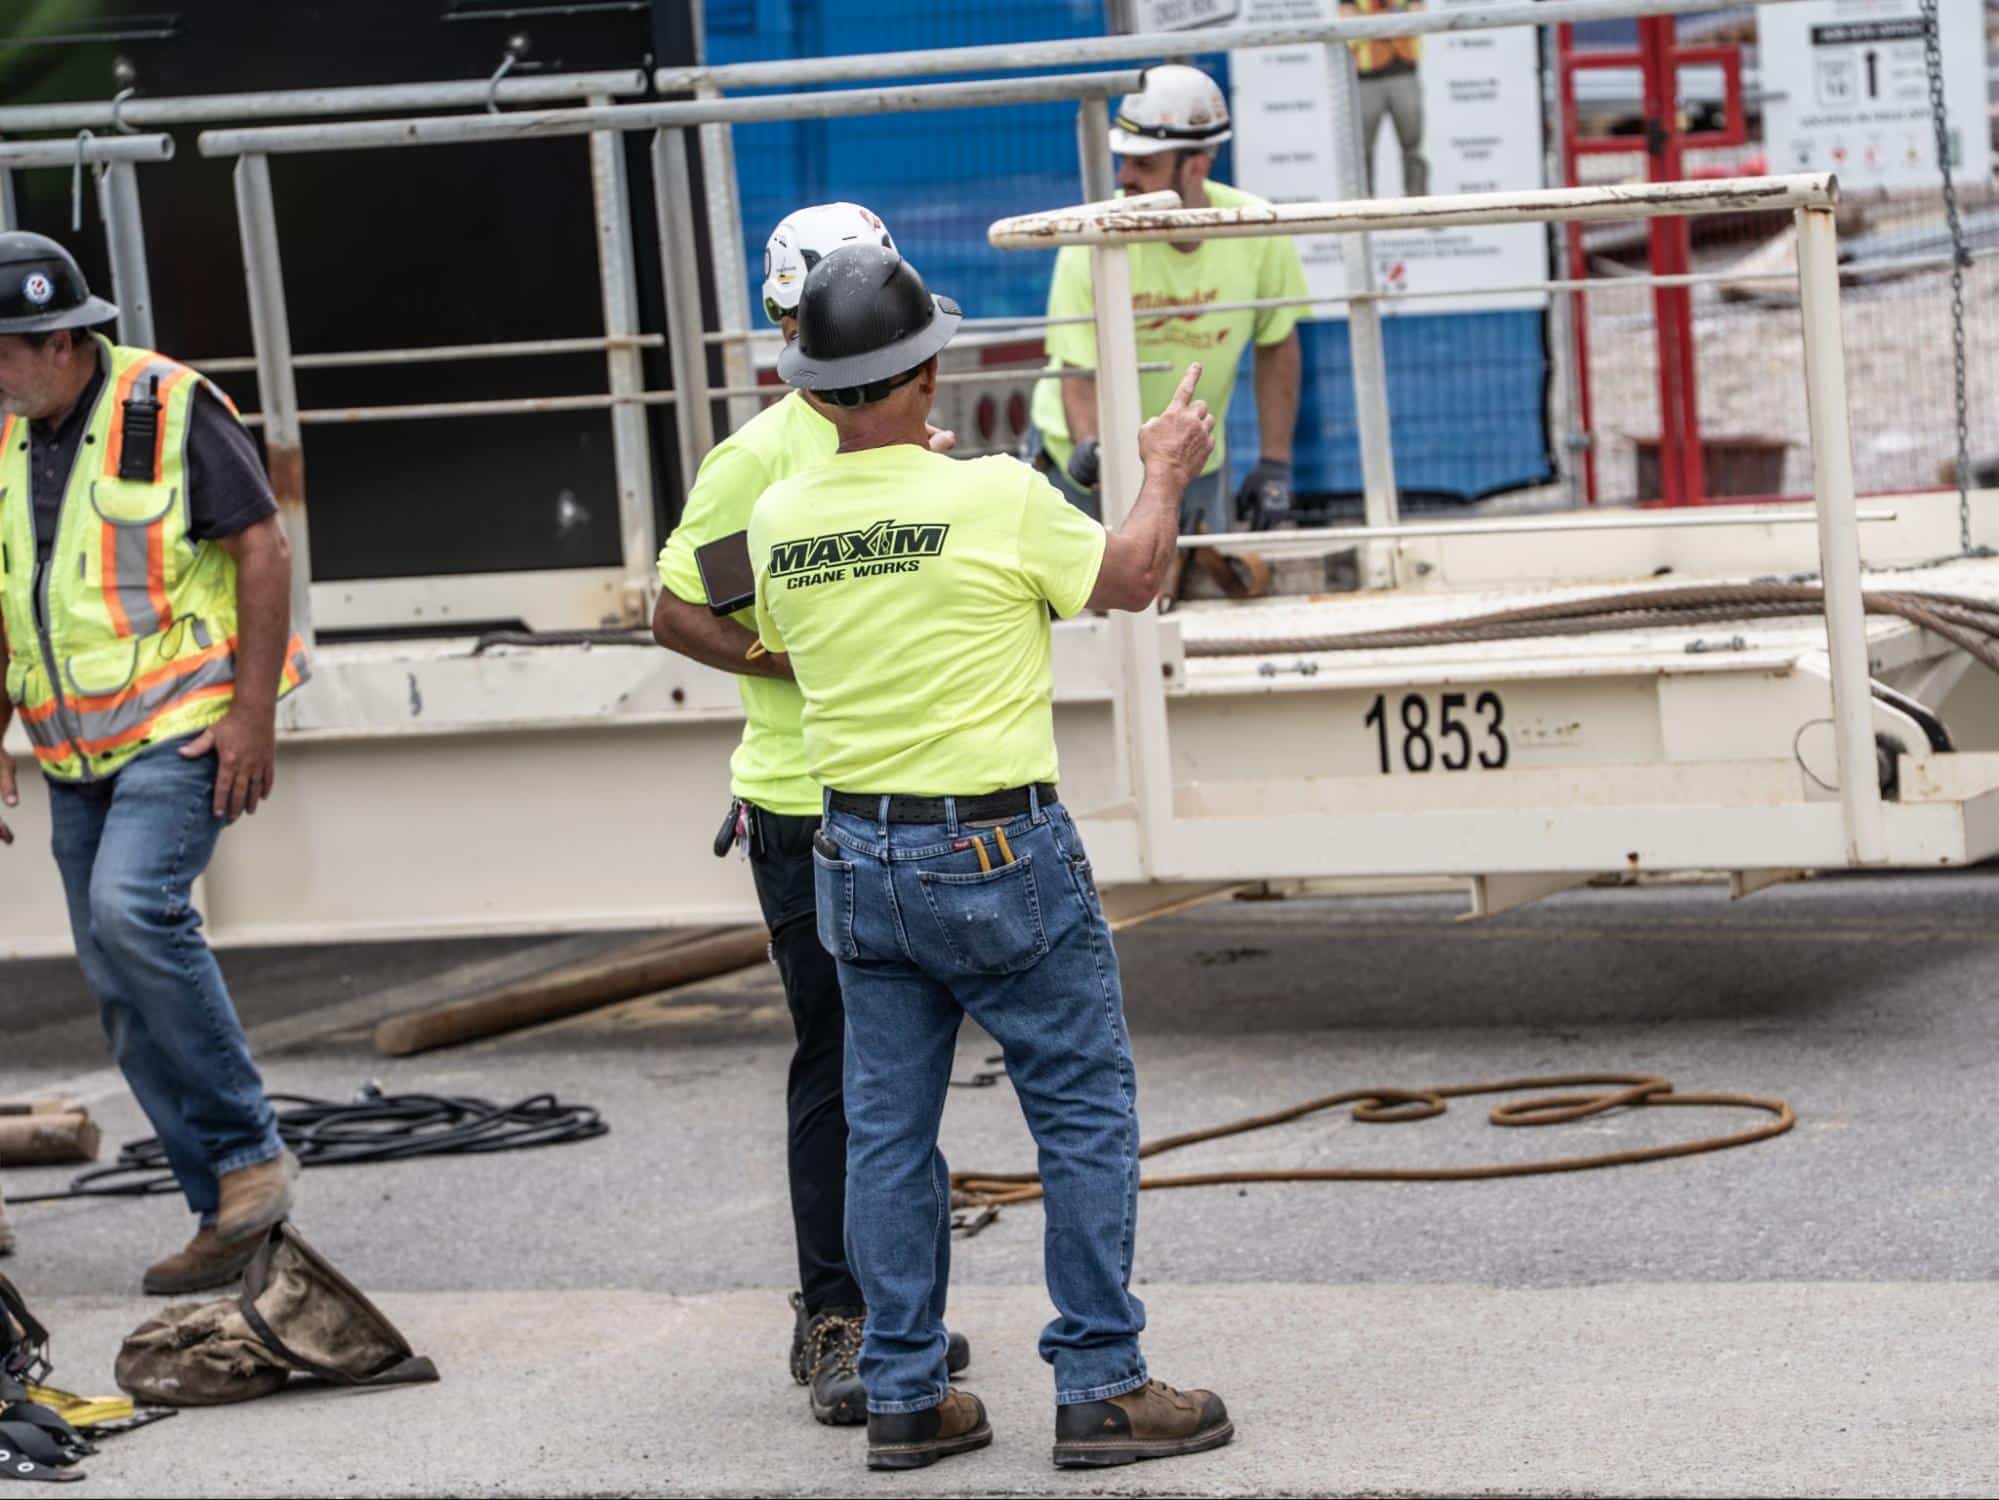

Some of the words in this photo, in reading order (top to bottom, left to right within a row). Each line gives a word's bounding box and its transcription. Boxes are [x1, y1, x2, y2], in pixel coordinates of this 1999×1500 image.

[769, 520, 950, 577] MAXIM
[786, 569, 846, 590] CRANE
[853, 560, 920, 578] WORKS
[1363, 690, 1509, 774] 1853
